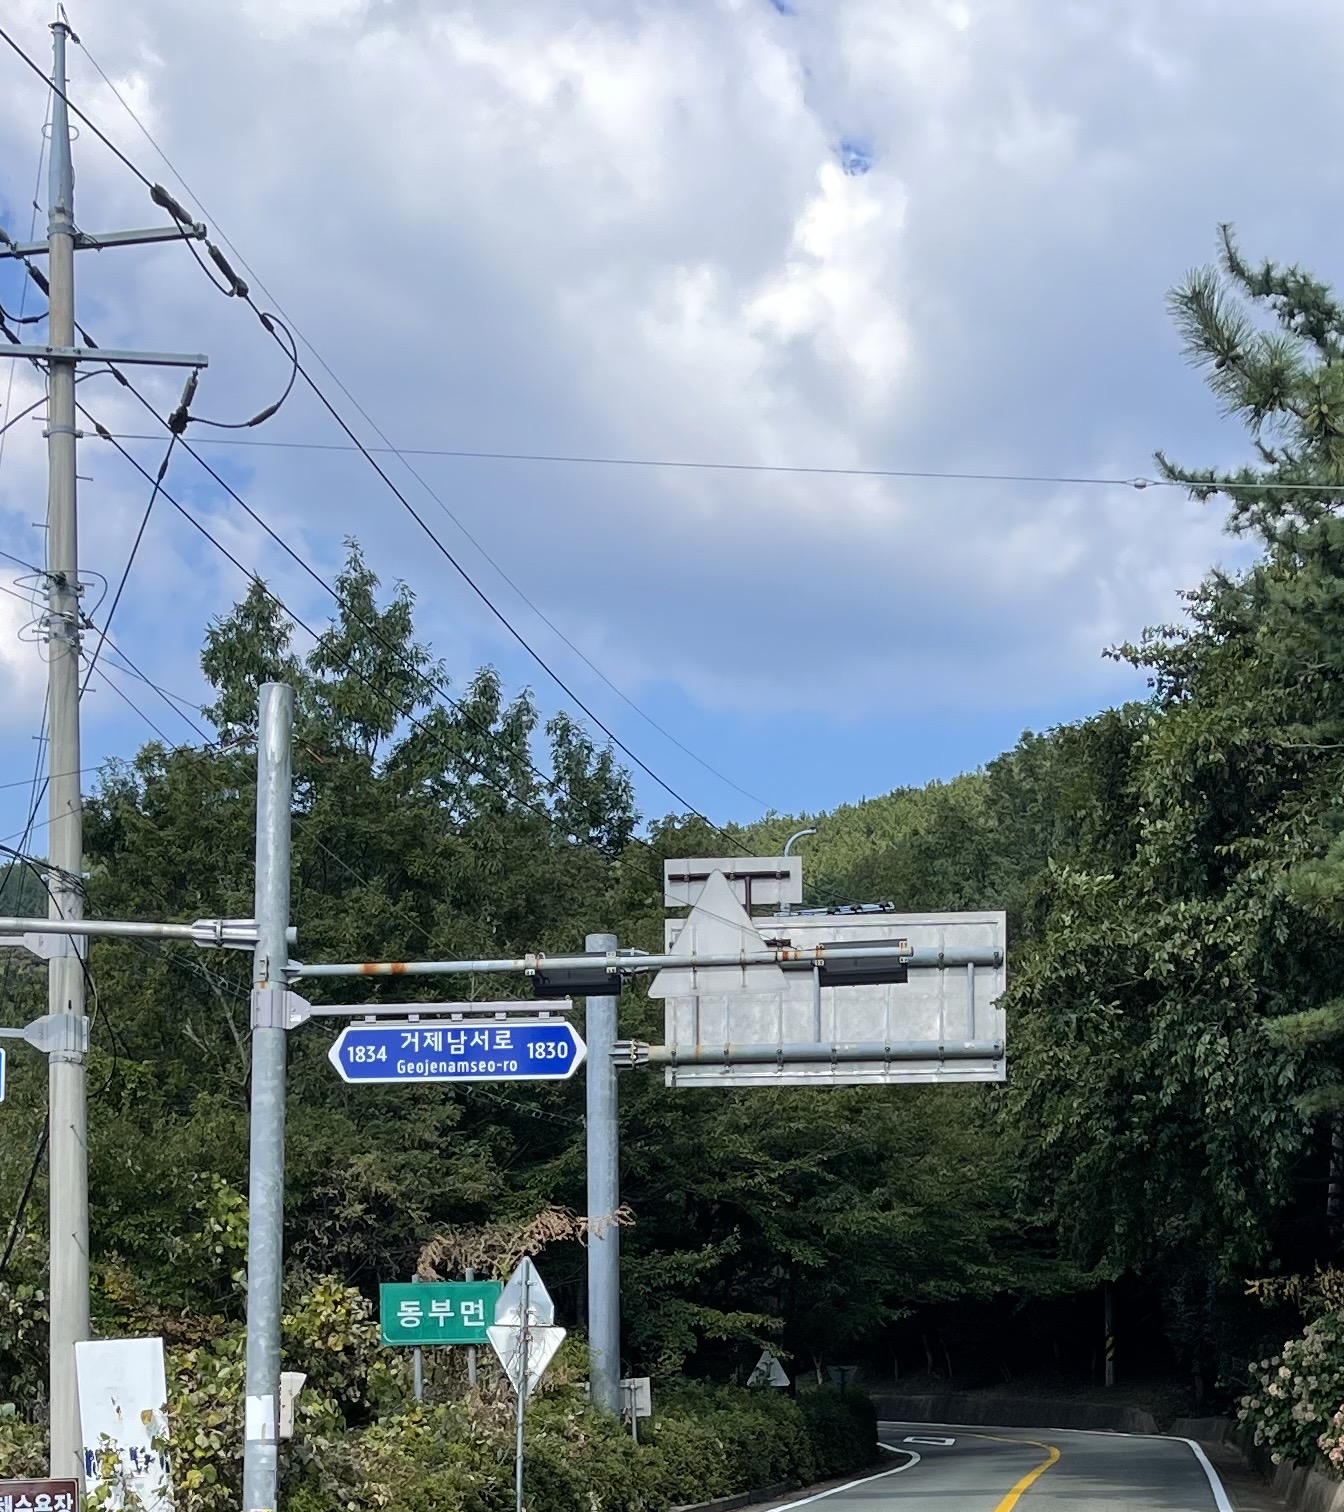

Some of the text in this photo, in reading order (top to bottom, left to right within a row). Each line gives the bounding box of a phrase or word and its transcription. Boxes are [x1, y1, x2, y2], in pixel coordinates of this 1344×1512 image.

[400, 1030, 514, 1055] 거제남서로
[527, 1041, 569, 1059] 1830
[347, 1045, 388, 1063] 1834
[396, 1058, 519, 1077] Geojenamseo-ro
[396, 1299, 485, 1328] 동부면
